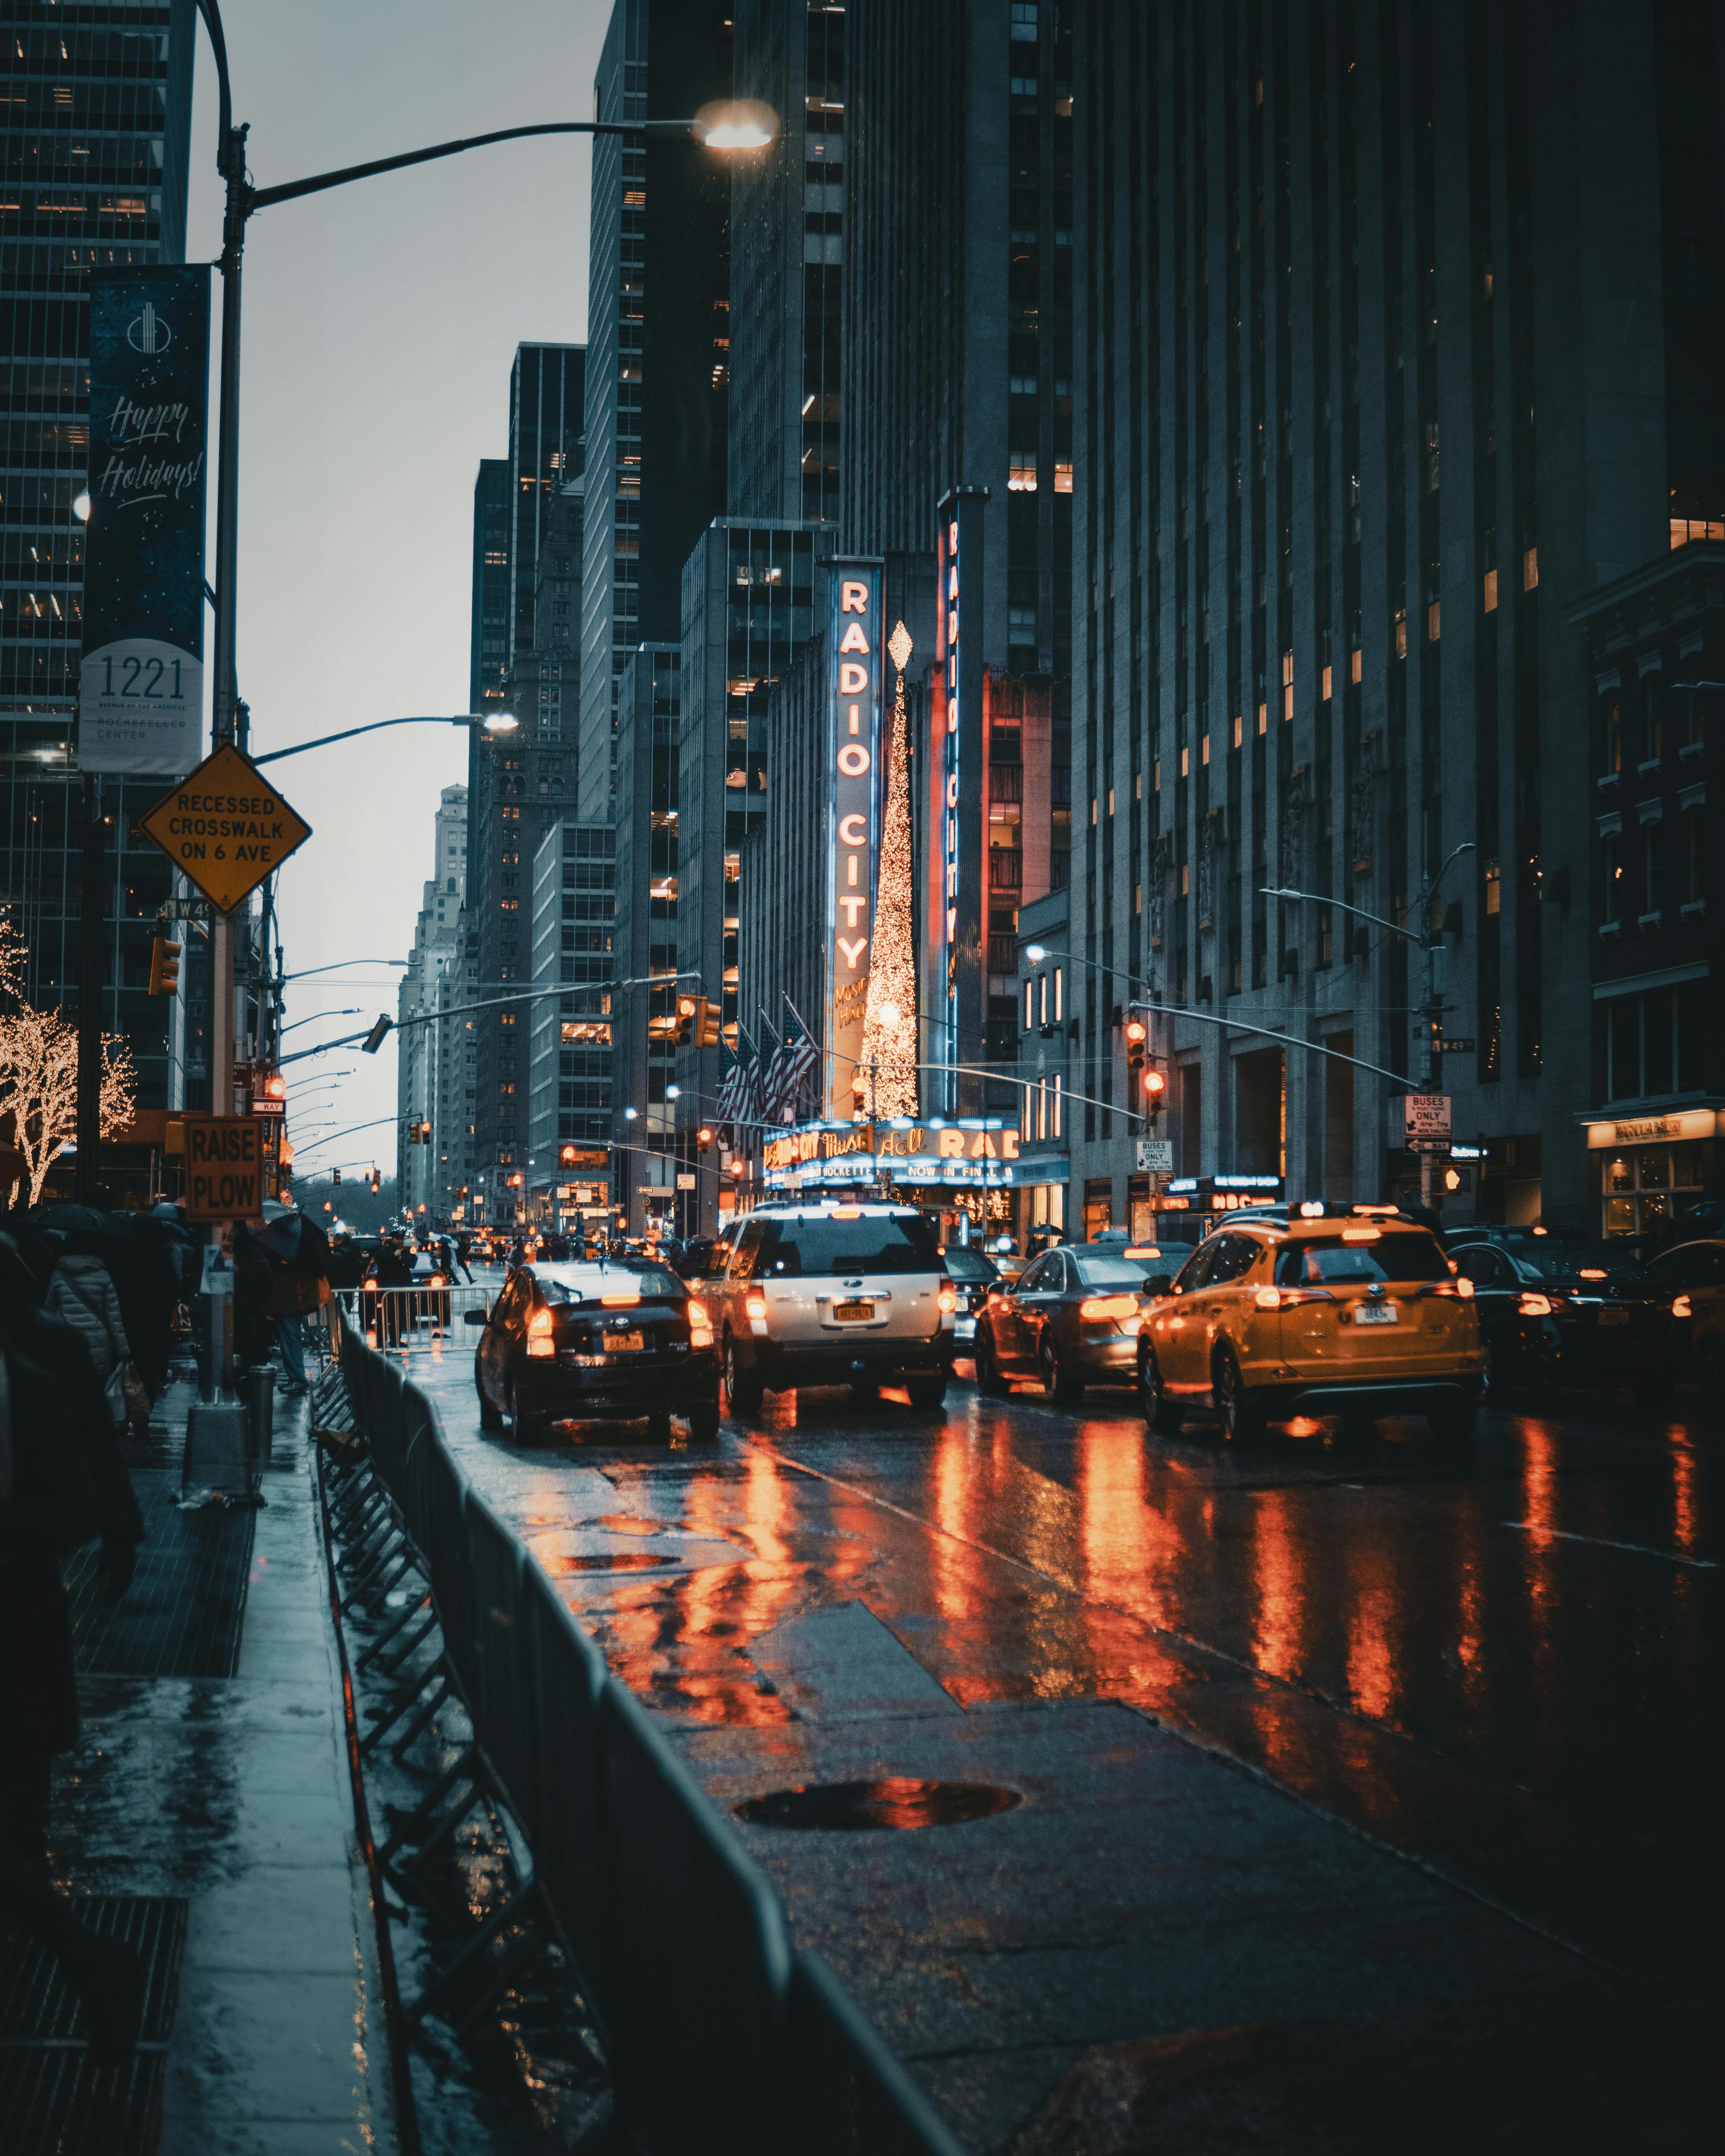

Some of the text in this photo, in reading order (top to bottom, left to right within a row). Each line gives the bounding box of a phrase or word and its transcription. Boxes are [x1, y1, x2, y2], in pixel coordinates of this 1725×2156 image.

[106, 396, 189, 444] Happy
[96, 451, 204, 499] Holidays!
[101, 655, 184, 699] 1221
[98, 718, 185, 728] ROCKEFELLER
[98, 730, 146, 740] CENTER
[836, 580, 870, 970] RADIO CITY
[178, 794, 275, 815] RECESSED
[169, 818, 283, 839] CROSSWALK
[181, 842, 271, 862] ON 6 AVE
[180, 903, 191, 917] W
[834, 976, 867, 1008] MUSIC
[1442, 1042, 1449, 1051] W
[1452, 1042, 1464, 1050] 49
[1413, 1097, 1444, 1106] BUSES
[1416, 1112, 1440, 1120] ONLY
[192, 1129, 255, 1162] RAISE
[822, 1131, 865, 1159] Musi
[877, 1127, 927, 1159] Hall
[908, 1166, 935, 1176] NOW
[944, 1166, 955, 1176] IN
[962, 1166, 997, 1177] FINL
[194, 1173, 255, 1208] PLOW
[1212, 1193, 1251, 1210] NBC
